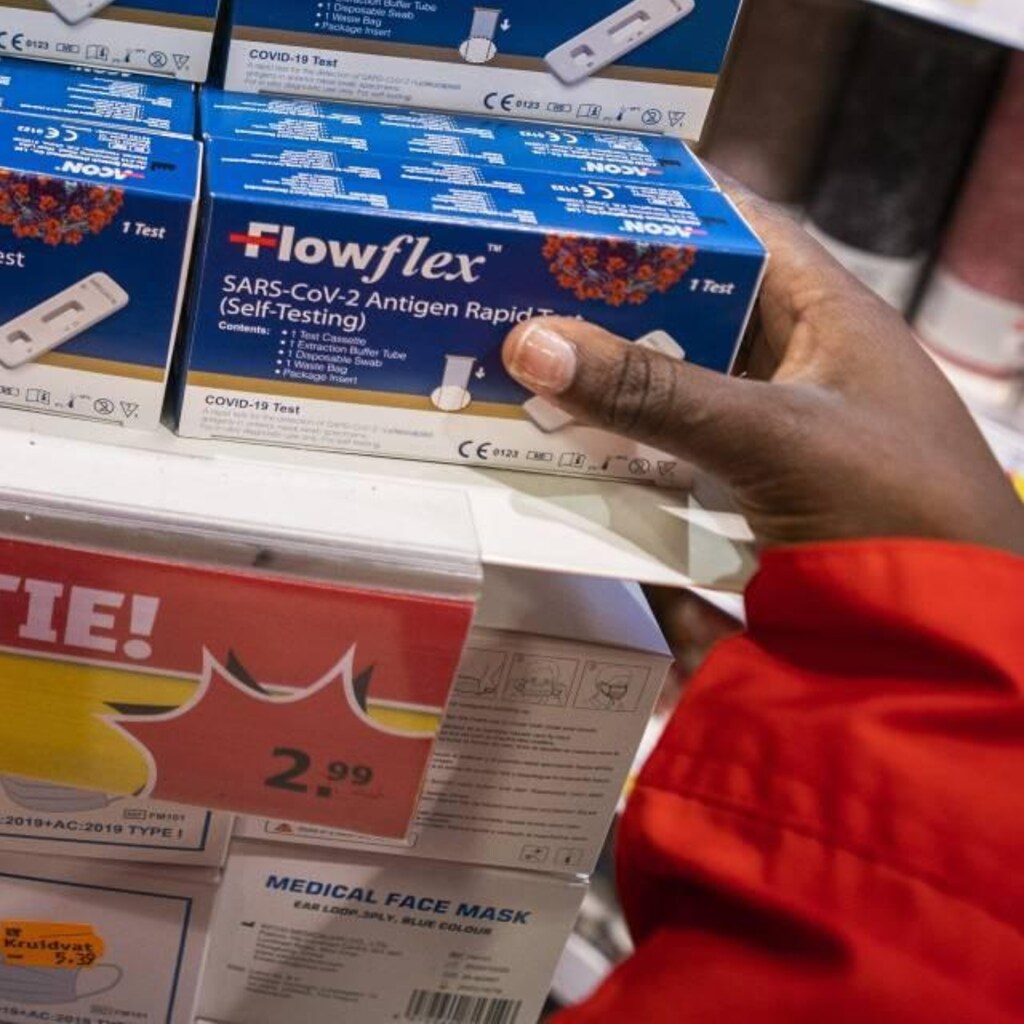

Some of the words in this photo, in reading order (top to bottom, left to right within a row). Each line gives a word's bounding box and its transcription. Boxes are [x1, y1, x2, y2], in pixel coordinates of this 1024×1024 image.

[26, 40, 49, 51] 0123
[249, 49, 308, 64] COVID-19
[312, 56, 338, 68] Test
[516, 100, 540, 111] 0123
[60, 161, 136, 179] ACON
[584, 160, 649, 177] ACON
[123, 222, 129, 233] 1
[135, 223, 166, 239] Test
[624, 220, 694, 238] ACON
[229, 222, 486, 283] Flowflex
[690, 279, 697, 291] 1
[702, 281, 735, 295] Test
[222, 275, 360, 307] SARS-CoV-2
[366, 292, 459, 319] Antigen
[466, 302, 533, 326] Rapid
[219, 298, 366, 332] (Self-Testing)
[218, 321, 270, 336] Contents:
[300, 330, 321, 341] Test
[297, 340, 348, 353] Extraction
[382, 350, 407, 361] Tube
[327, 363, 348, 375] Bag
[355, 356, 383, 367] Swab
[283, 369, 327, 383] Package
[205, 395, 268, 411] COVID-19
[273, 402, 300, 415] Test
[493, 448, 519, 458] 0123
[264, 747, 373, 798] 2.99
[129, 826, 171, 838] TYPE
[266, 874, 378, 904] MEDICAL
[384, 892, 451, 914] FACE
[456, 902, 531, 925] MASK
[294, 900, 319, 912] EAR
[402, 916, 435, 929] BLUE
[438, 921, 493, 935] COLOUR
[3, 939, 94, 953] Kruidvat
